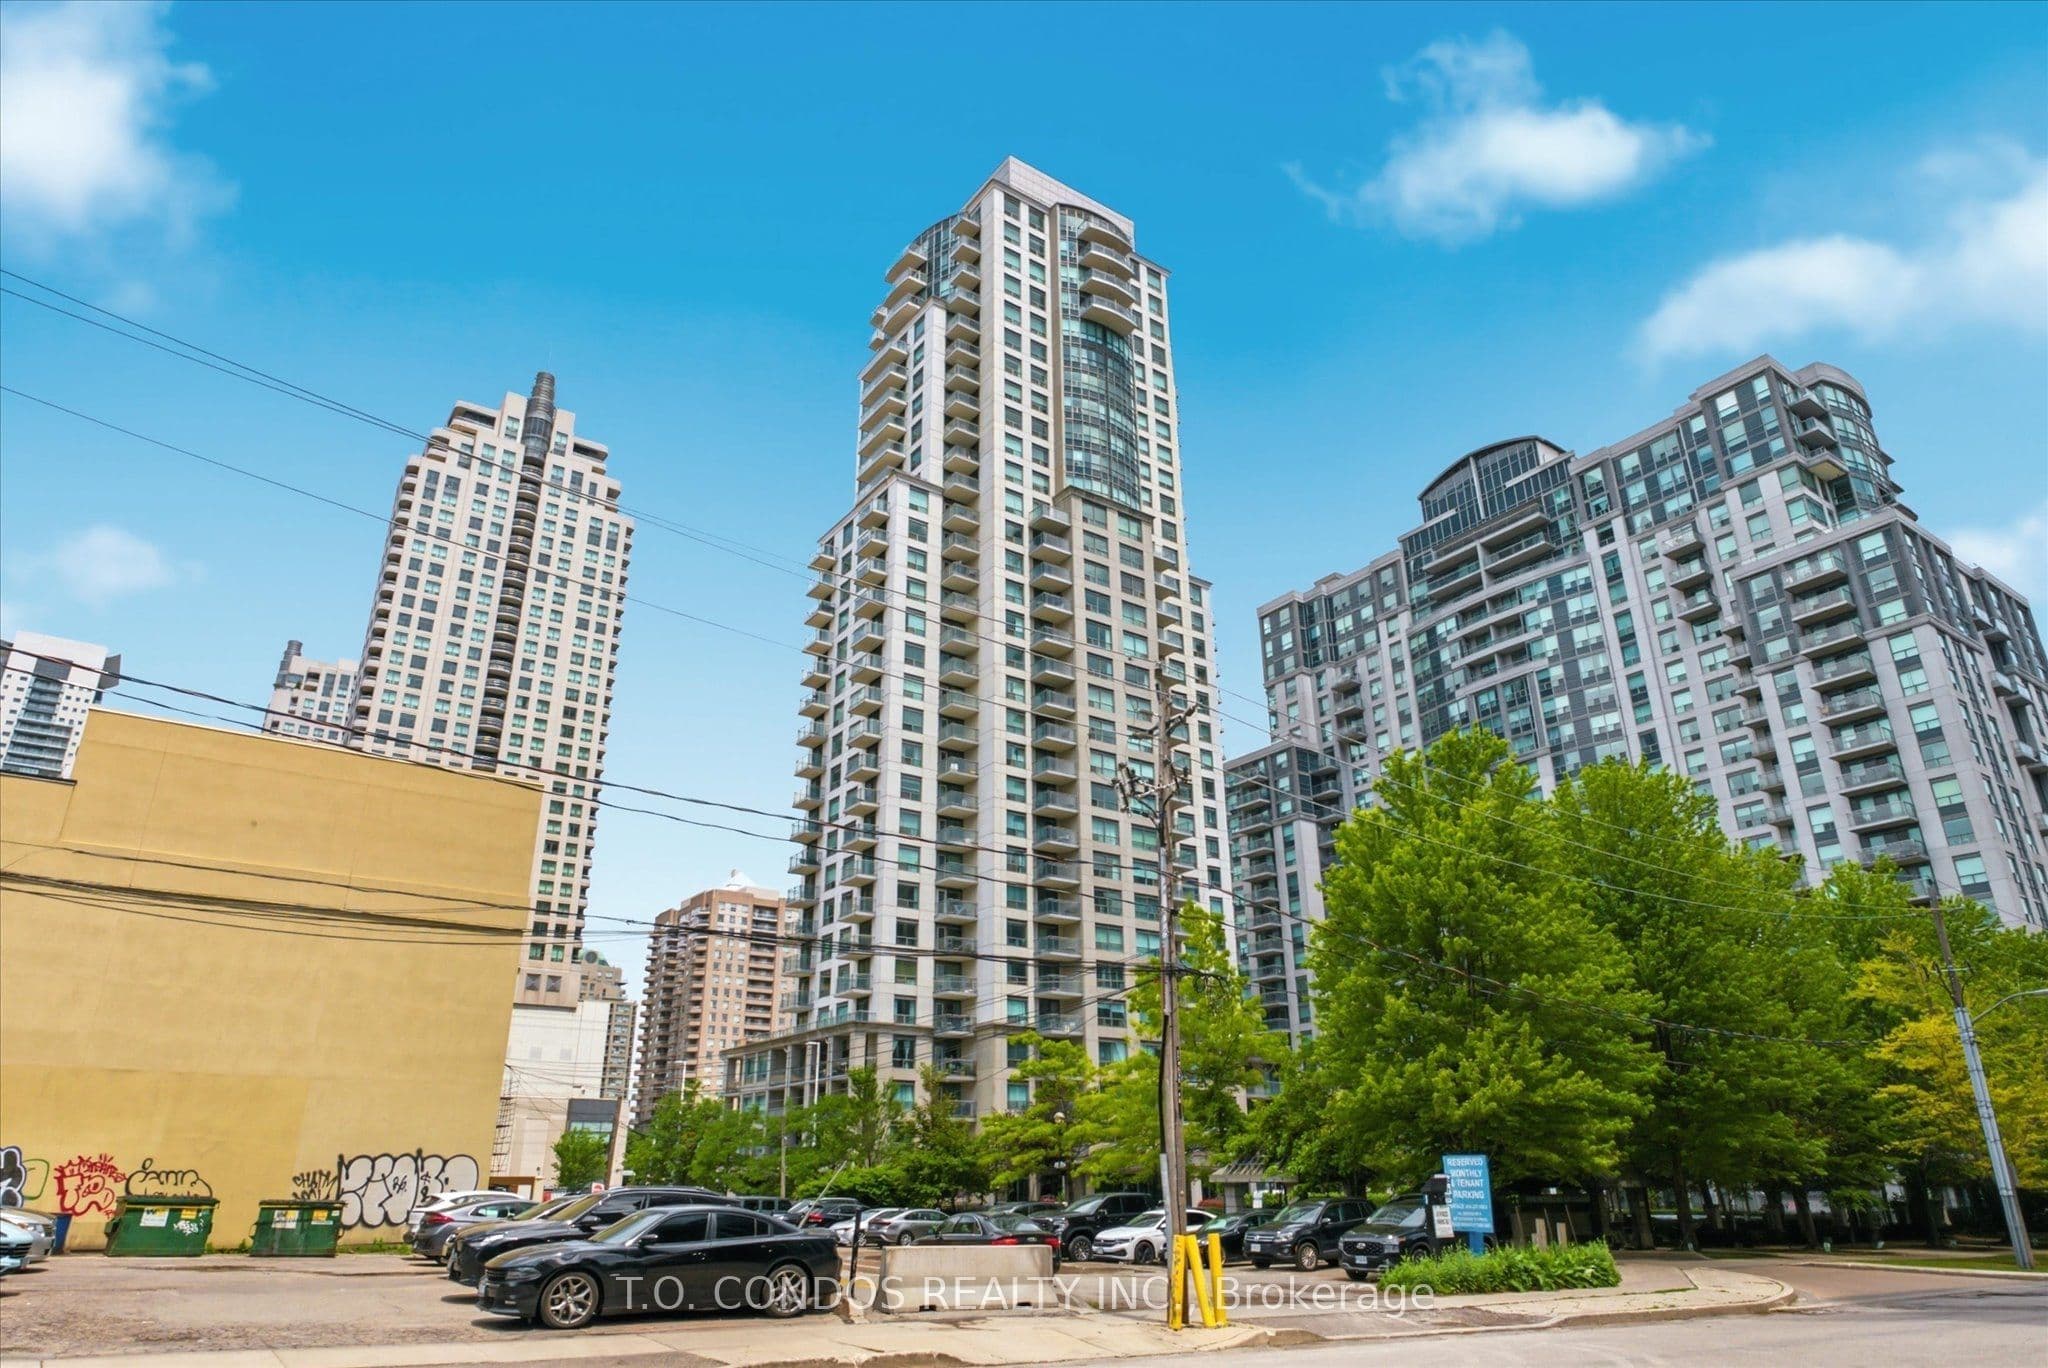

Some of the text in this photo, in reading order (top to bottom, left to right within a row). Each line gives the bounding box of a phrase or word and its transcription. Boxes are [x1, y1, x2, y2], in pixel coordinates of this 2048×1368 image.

[1447, 1158, 1483, 1166] RESERVED
[1450, 1168, 1482, 1177] MONTHLY
[1457, 1179, 1483, 1188] TENANT
[1452, 1190, 1485, 1199] PARKING
